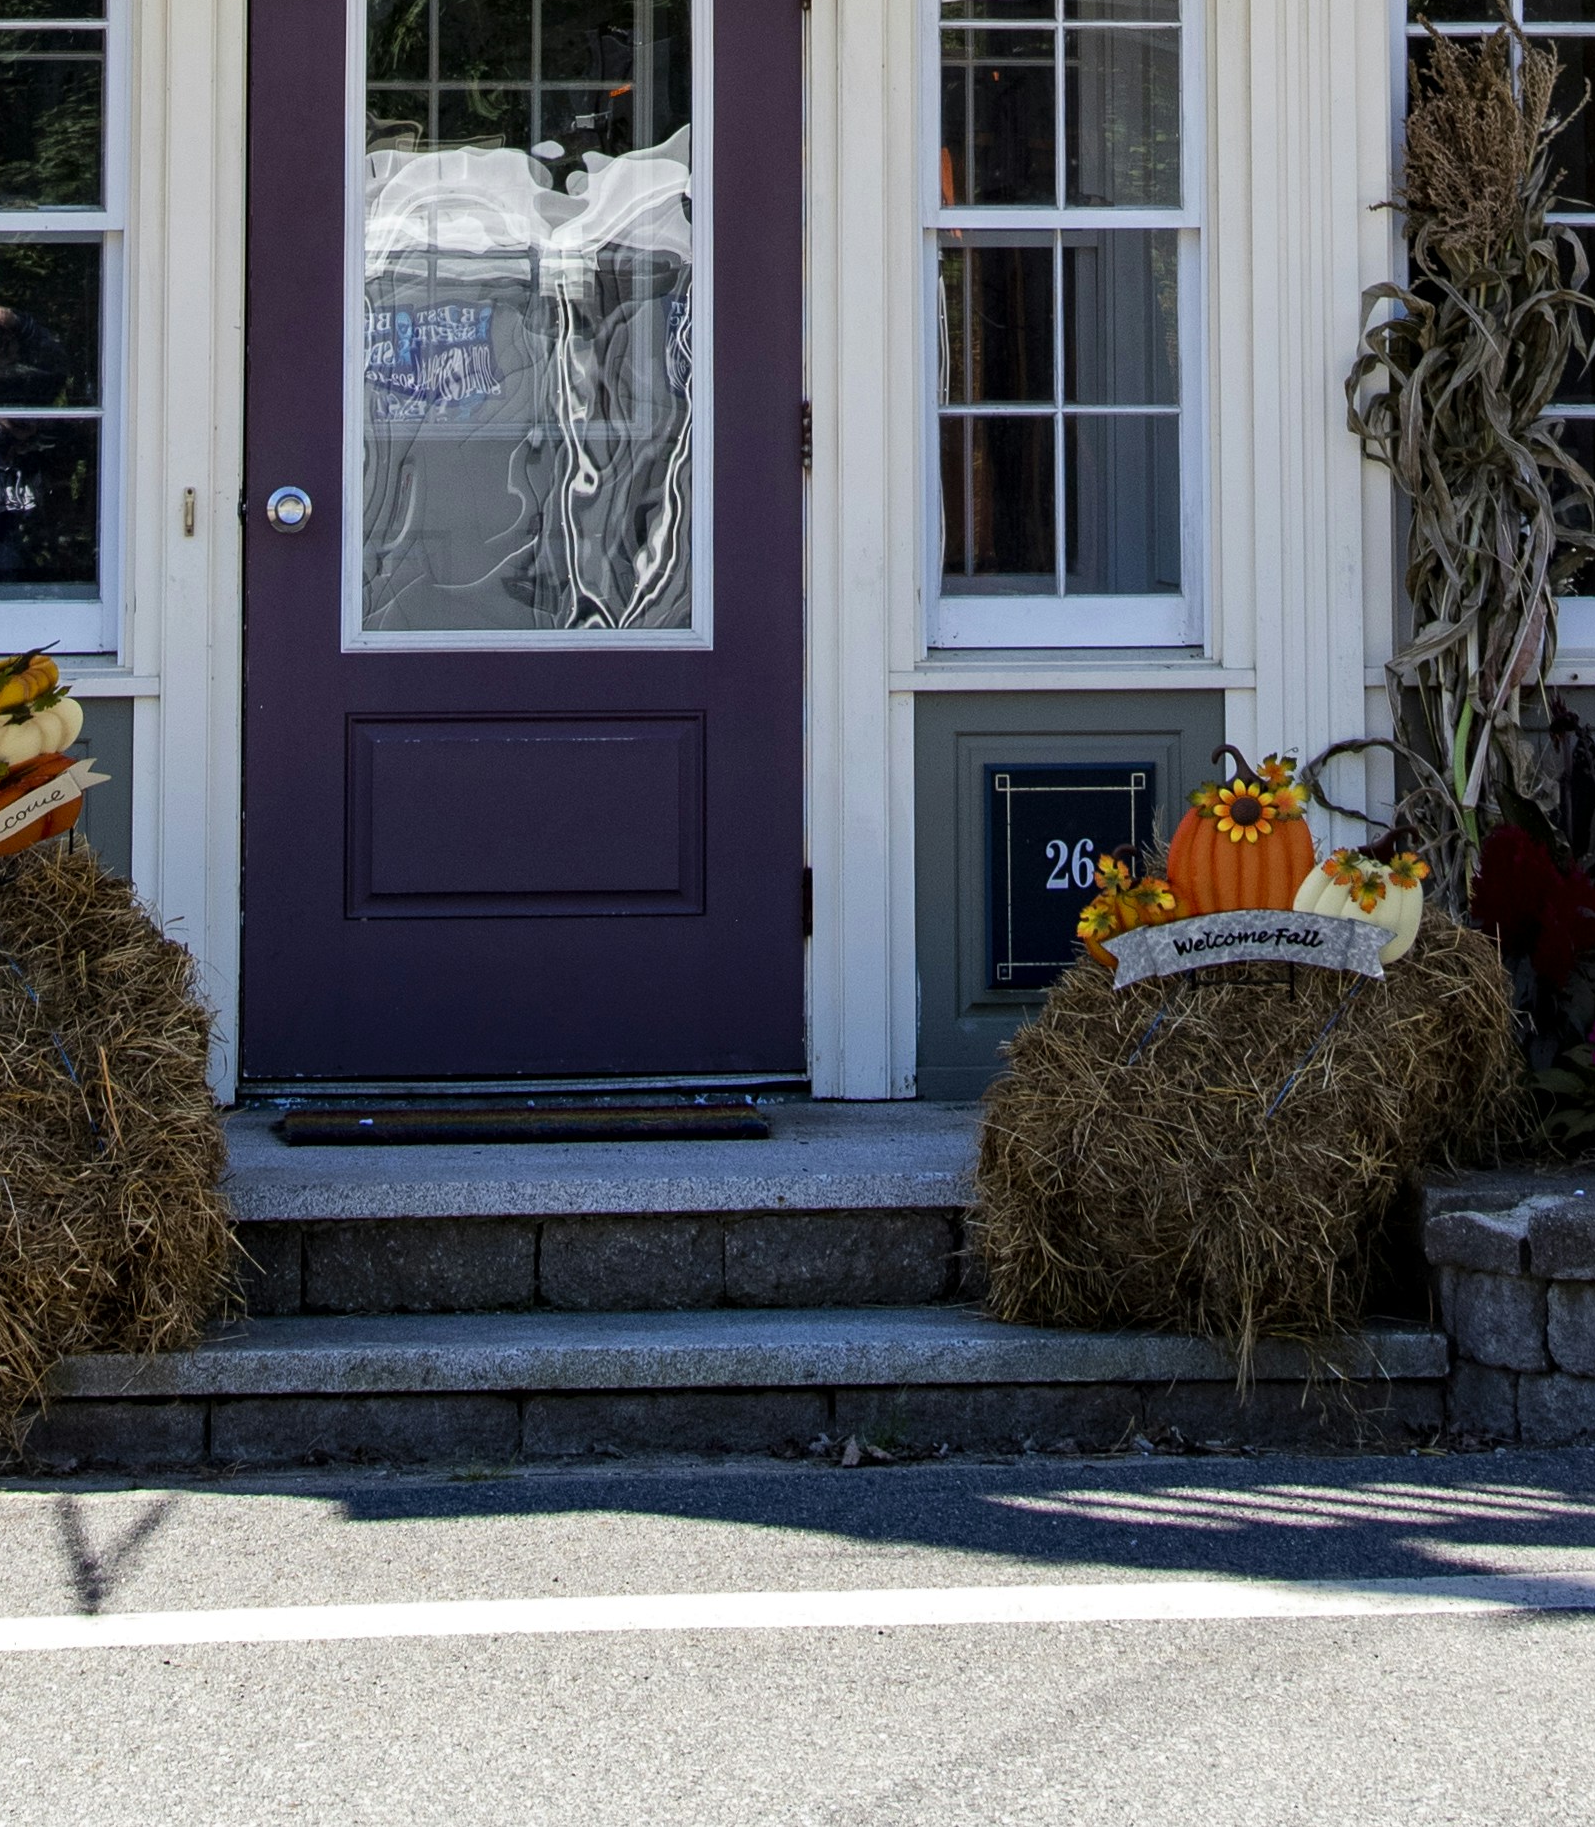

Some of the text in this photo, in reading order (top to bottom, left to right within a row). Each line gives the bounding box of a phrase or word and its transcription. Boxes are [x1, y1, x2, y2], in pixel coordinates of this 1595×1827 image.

[1045, 838, 1094, 890] 26
[1172, 928, 1324, 957] Welcome Fall
